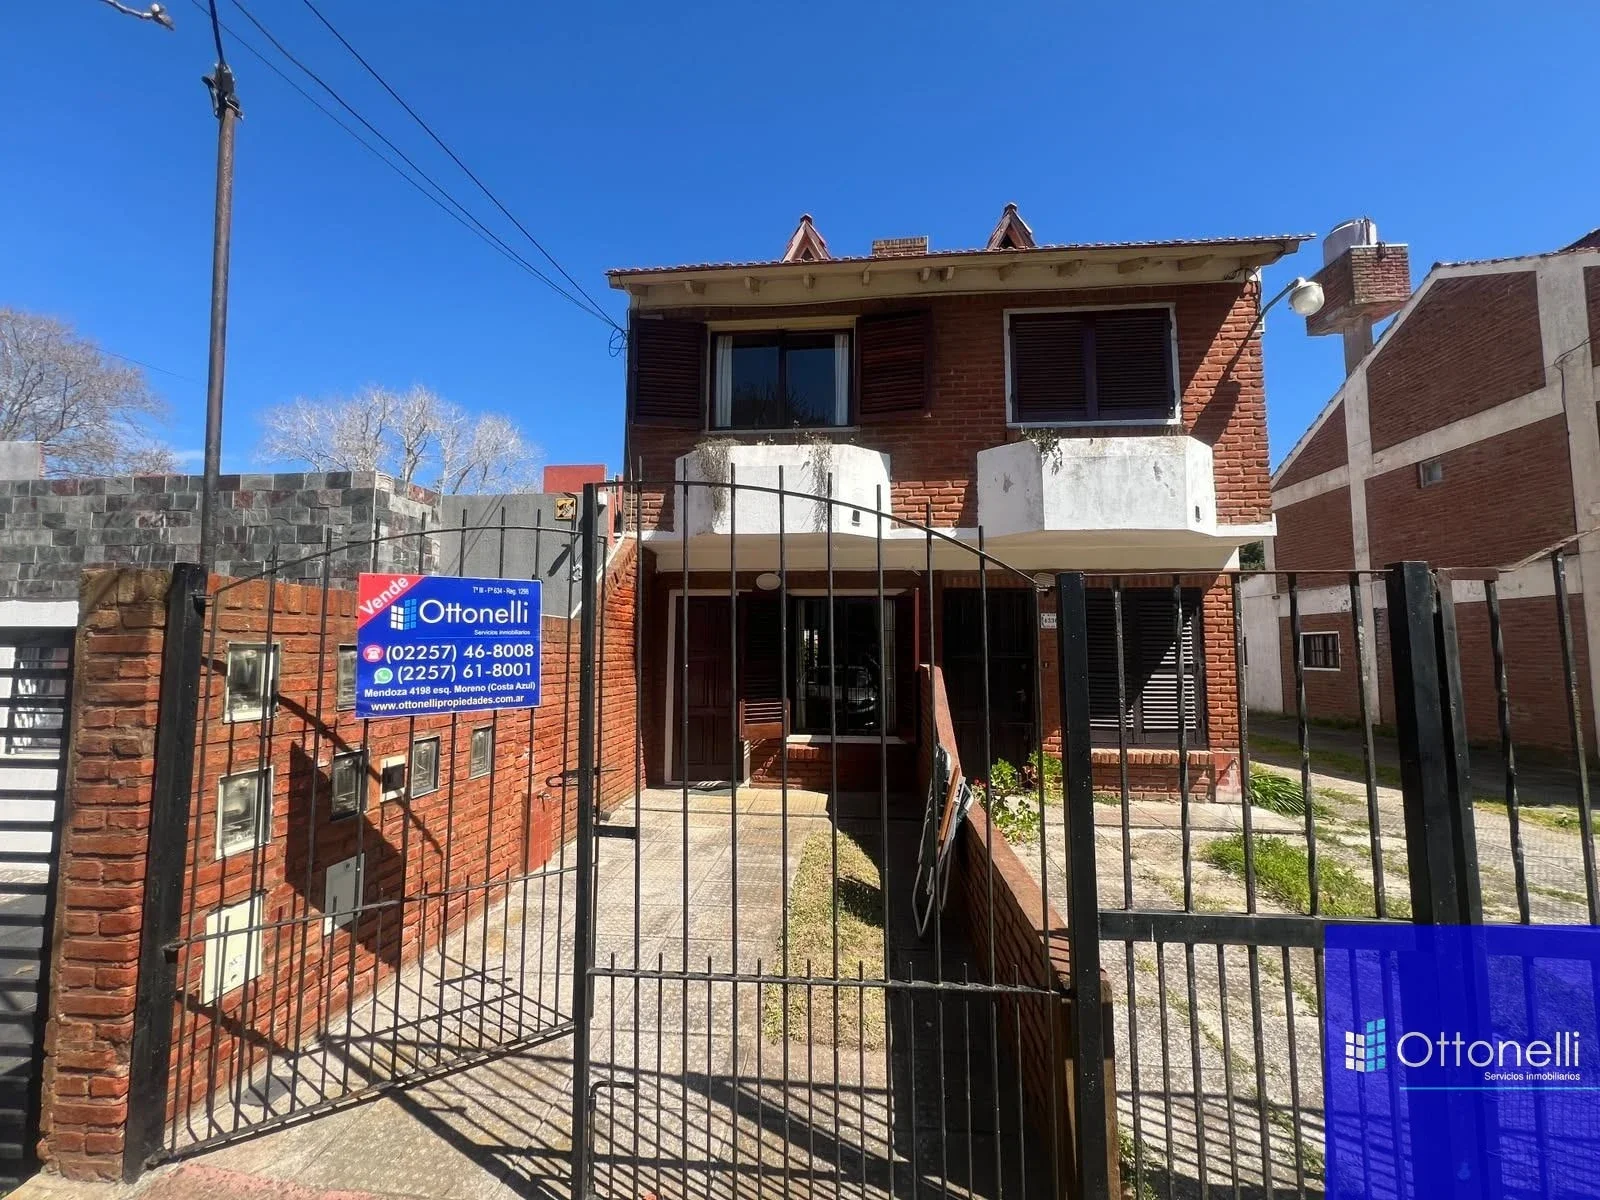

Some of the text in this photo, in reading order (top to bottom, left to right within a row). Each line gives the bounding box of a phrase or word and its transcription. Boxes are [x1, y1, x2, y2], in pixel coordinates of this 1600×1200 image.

[359, 577, 409, 615] Vende
[419, 599, 529, 624] Ottonelli
[386, 644, 534, 664] (02257) 46-8008
[398, 663, 531, 684] (2257) 61-8001
[364, 681, 536, 698] Mendoza 4198 esq. Moreno (Costa Azul)
[371, 695, 525, 712] www.ottonellipropiedades.com.ar
